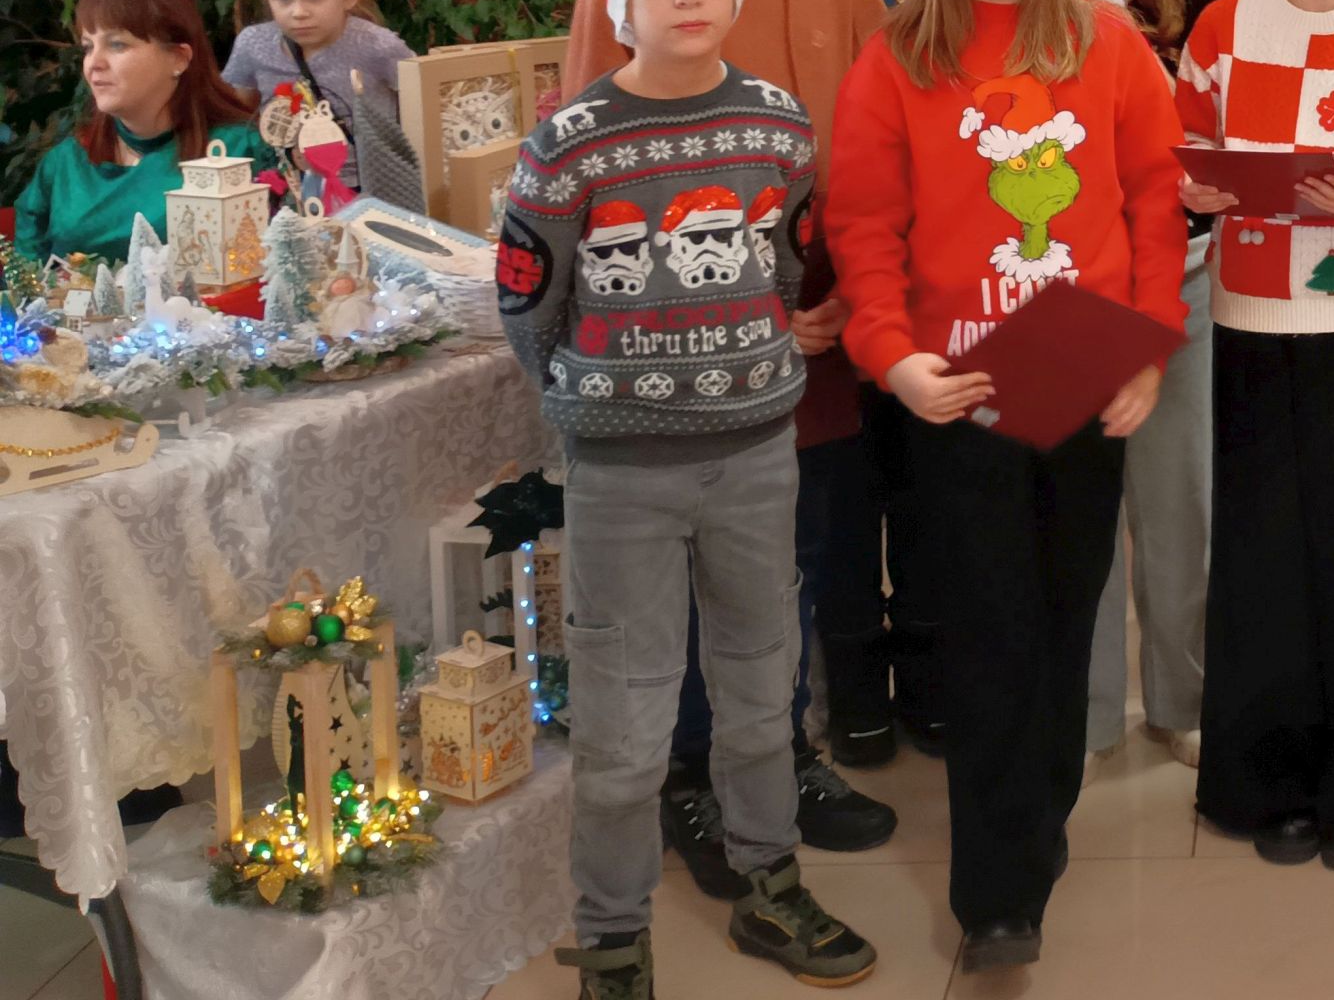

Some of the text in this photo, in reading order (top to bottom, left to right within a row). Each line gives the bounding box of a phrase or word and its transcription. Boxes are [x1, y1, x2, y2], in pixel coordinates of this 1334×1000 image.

[981, 277, 992, 315] I
[619, 325, 681, 356] thru
[686, 324, 727, 353] the
